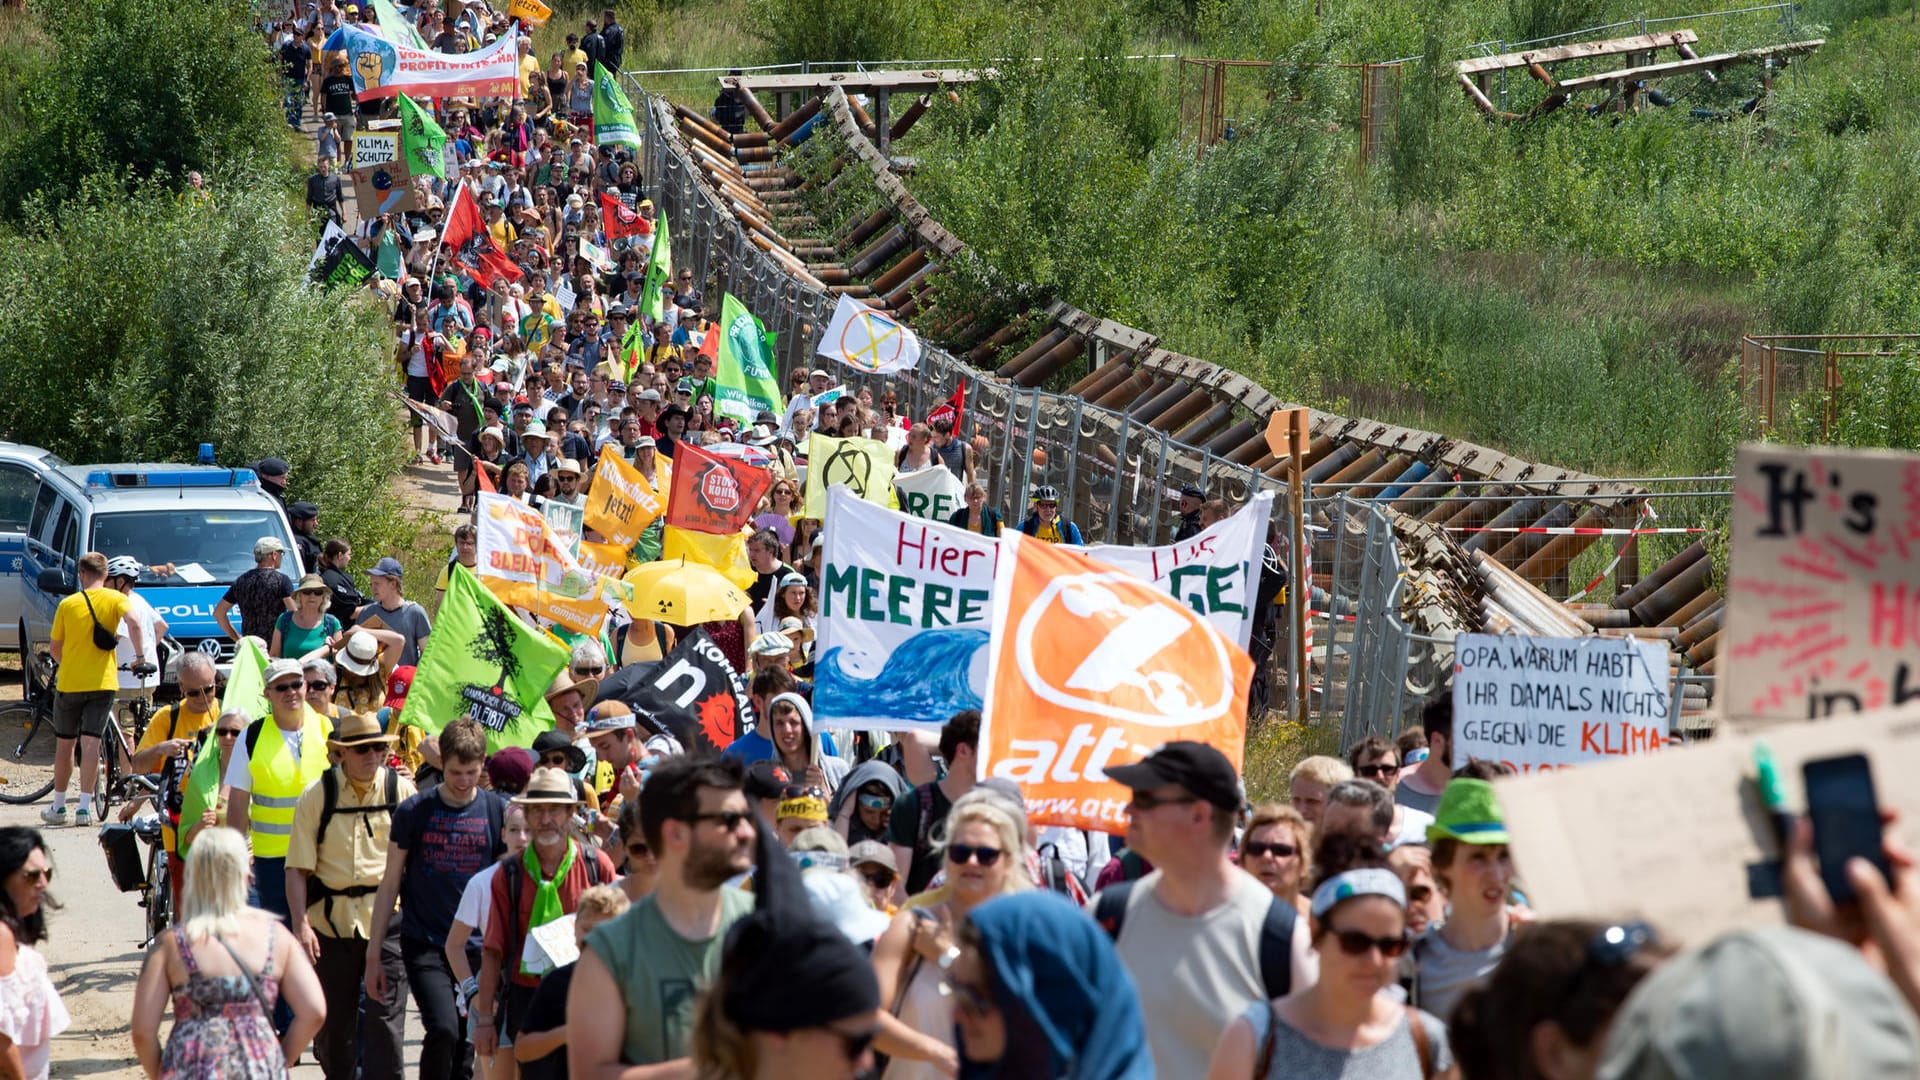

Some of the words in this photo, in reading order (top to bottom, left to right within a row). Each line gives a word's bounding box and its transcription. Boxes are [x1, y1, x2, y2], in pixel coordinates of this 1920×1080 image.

[356, 151, 393, 163] SCHUTZ
[357, 138, 394, 150] KLIMA-
[1755, 462, 1878, 537] It's
[897, 521, 985, 577] Hier
[1511, 648, 1578, 673] WARUM
[1586, 651, 1639, 679] HABT
[1466, 682, 1498, 705] IHR
[1510, 682, 1593, 712] DAMALS
[1601, 690, 1668, 719] NICHTS
[993, 723, 1150, 785] att
[1462, 719, 1526, 746] GEGEN
[1537, 722, 1566, 747] DIE
[1580, 720, 1670, 756] KLIMA-
